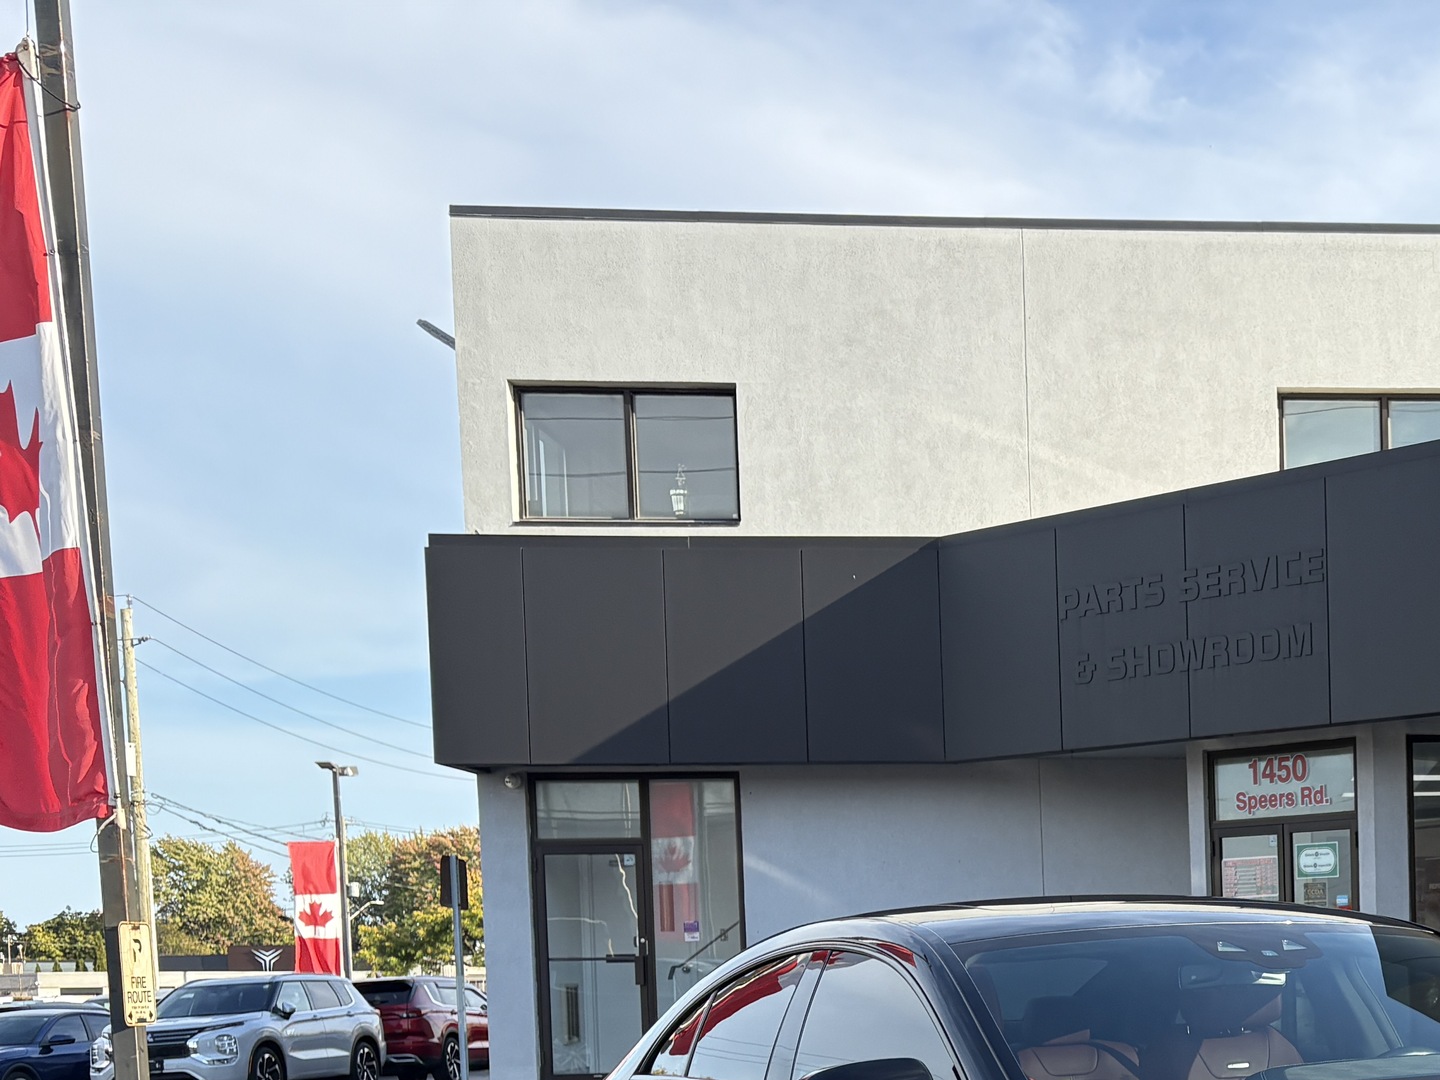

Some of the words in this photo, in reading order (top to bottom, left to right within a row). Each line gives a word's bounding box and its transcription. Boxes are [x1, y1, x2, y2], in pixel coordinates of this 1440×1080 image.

[1059, 573, 1166, 623] PARTS
[1178, 548, 1325, 603] SERVICE
[1075, 653, 1098, 685] &
[1107, 622, 1314, 682] SHOWROOM
[1248, 754, 1308, 786] 1450
[1235, 790, 1296, 815] Speers
[1300, 785, 1332, 807] Rd.
[127, 990, 152, 1004] ROUTE
[131, 976, 147, 989] FIRE
